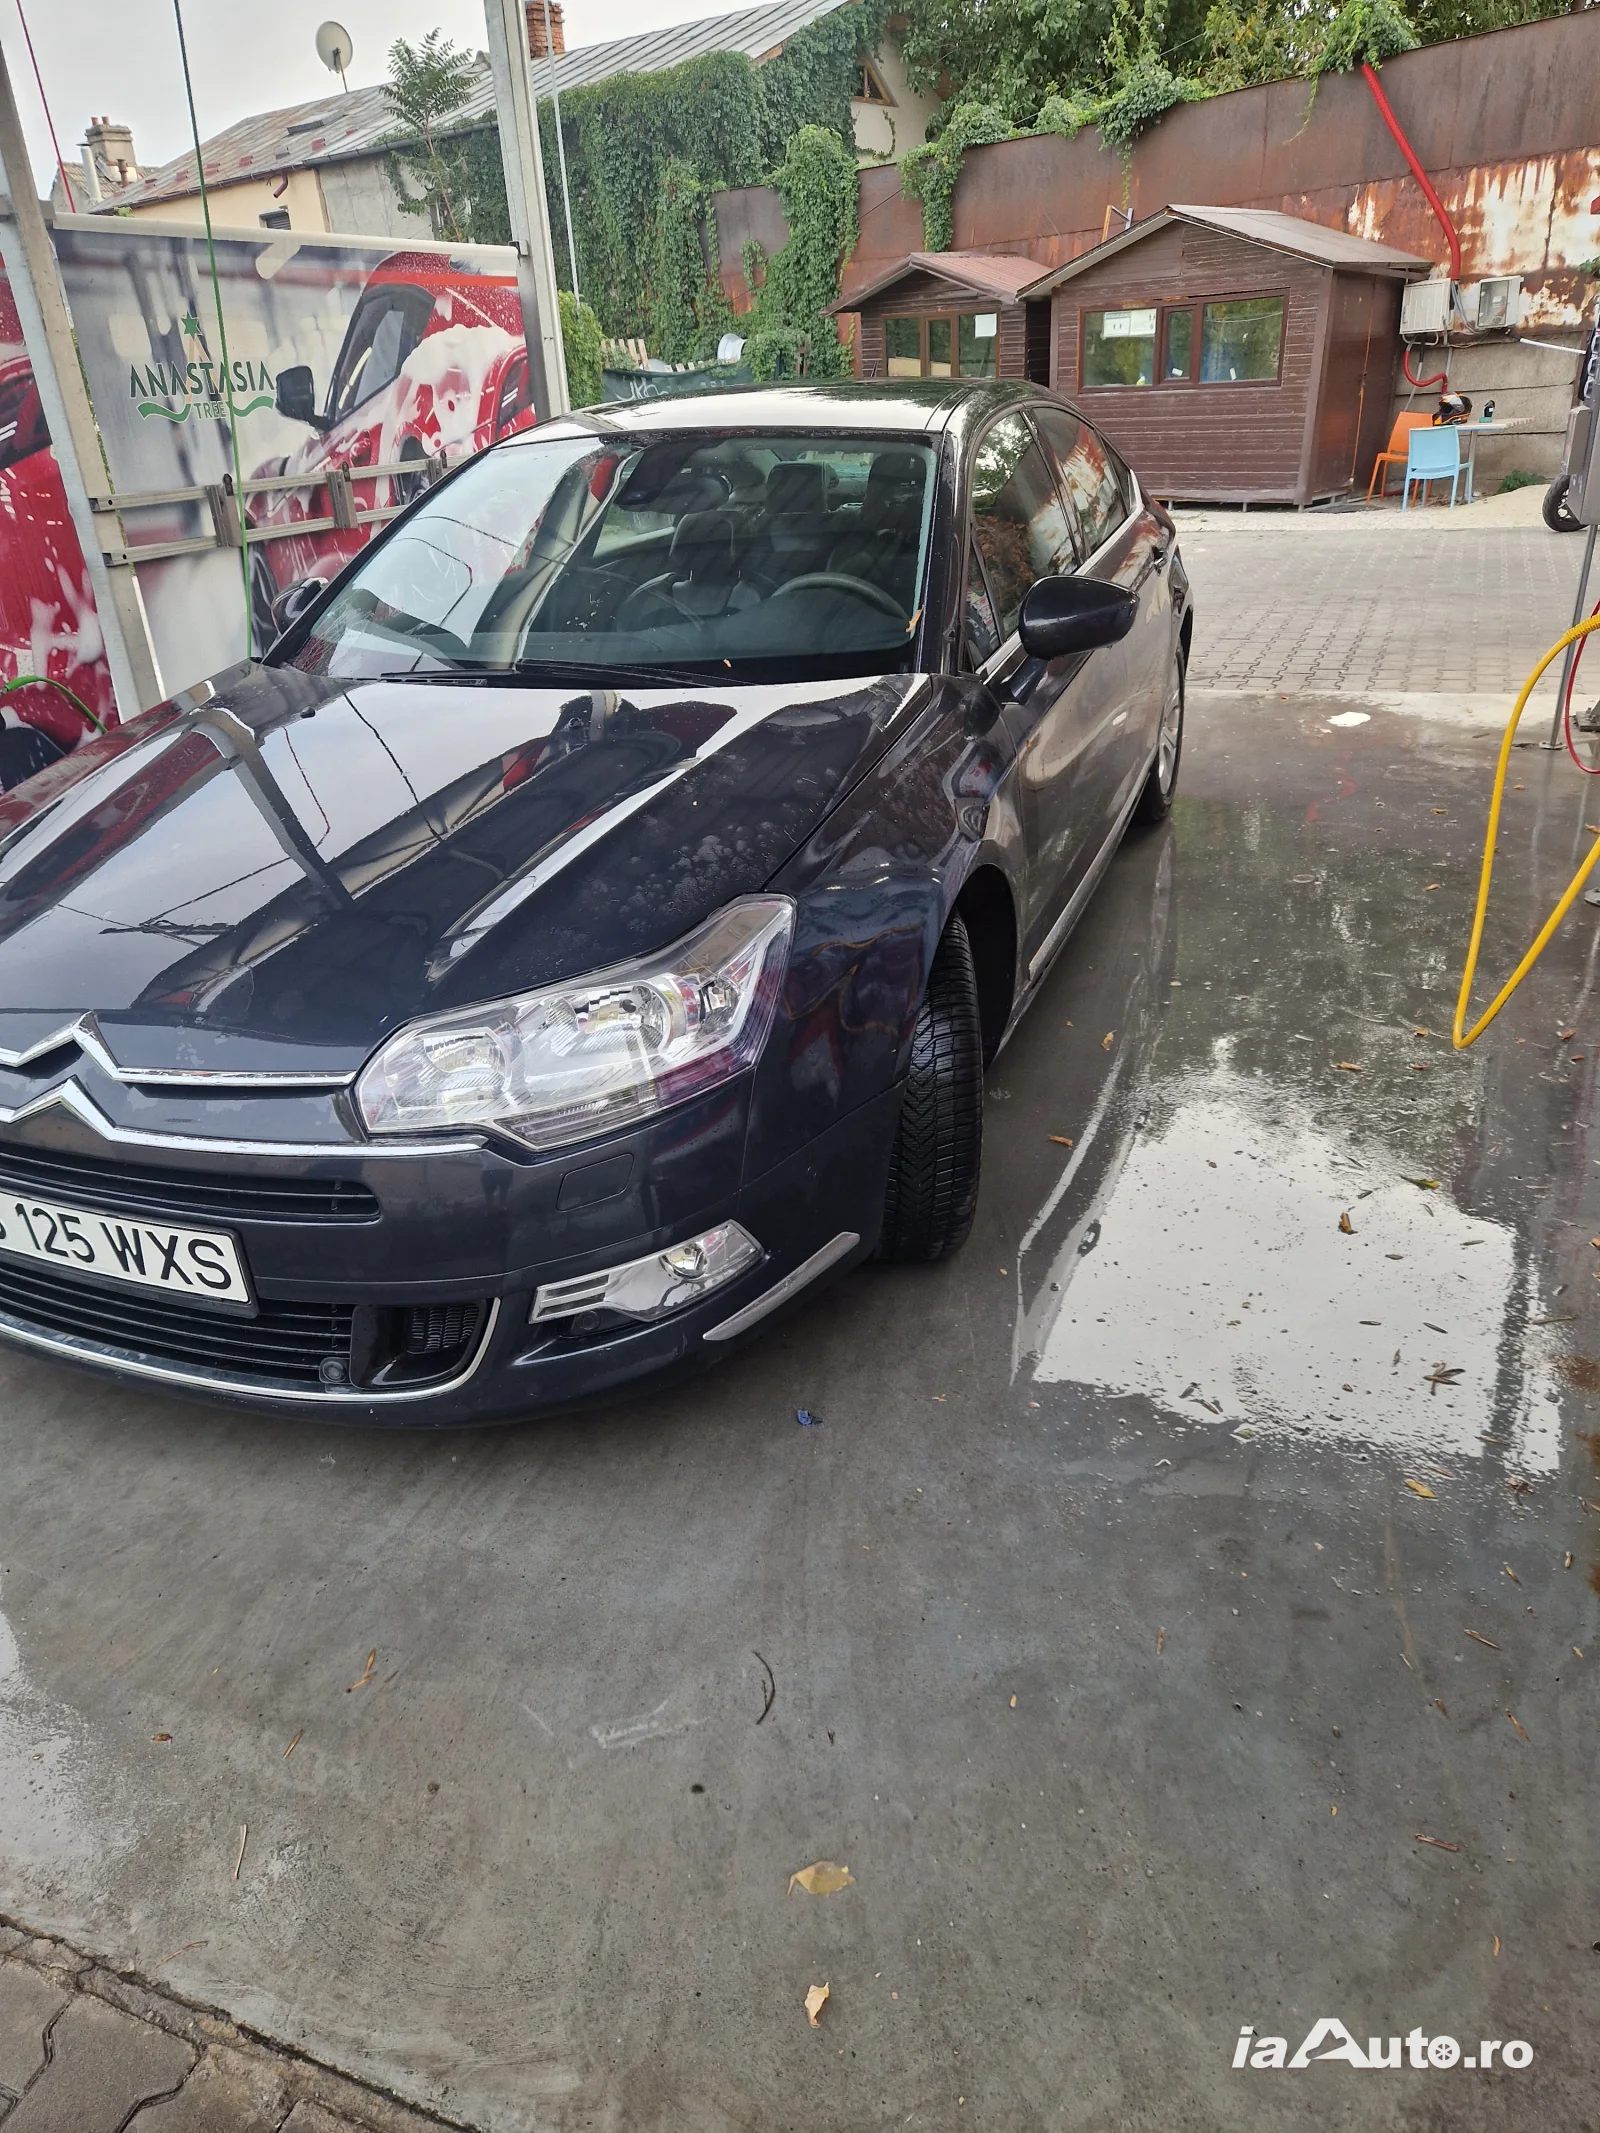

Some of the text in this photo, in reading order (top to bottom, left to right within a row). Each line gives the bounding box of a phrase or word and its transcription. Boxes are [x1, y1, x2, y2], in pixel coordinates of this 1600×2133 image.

[130, 361, 275, 398] ANASTASIA
[194, 401, 226, 418] TREE
[15, 1203, 232, 1290] 125 WXS
